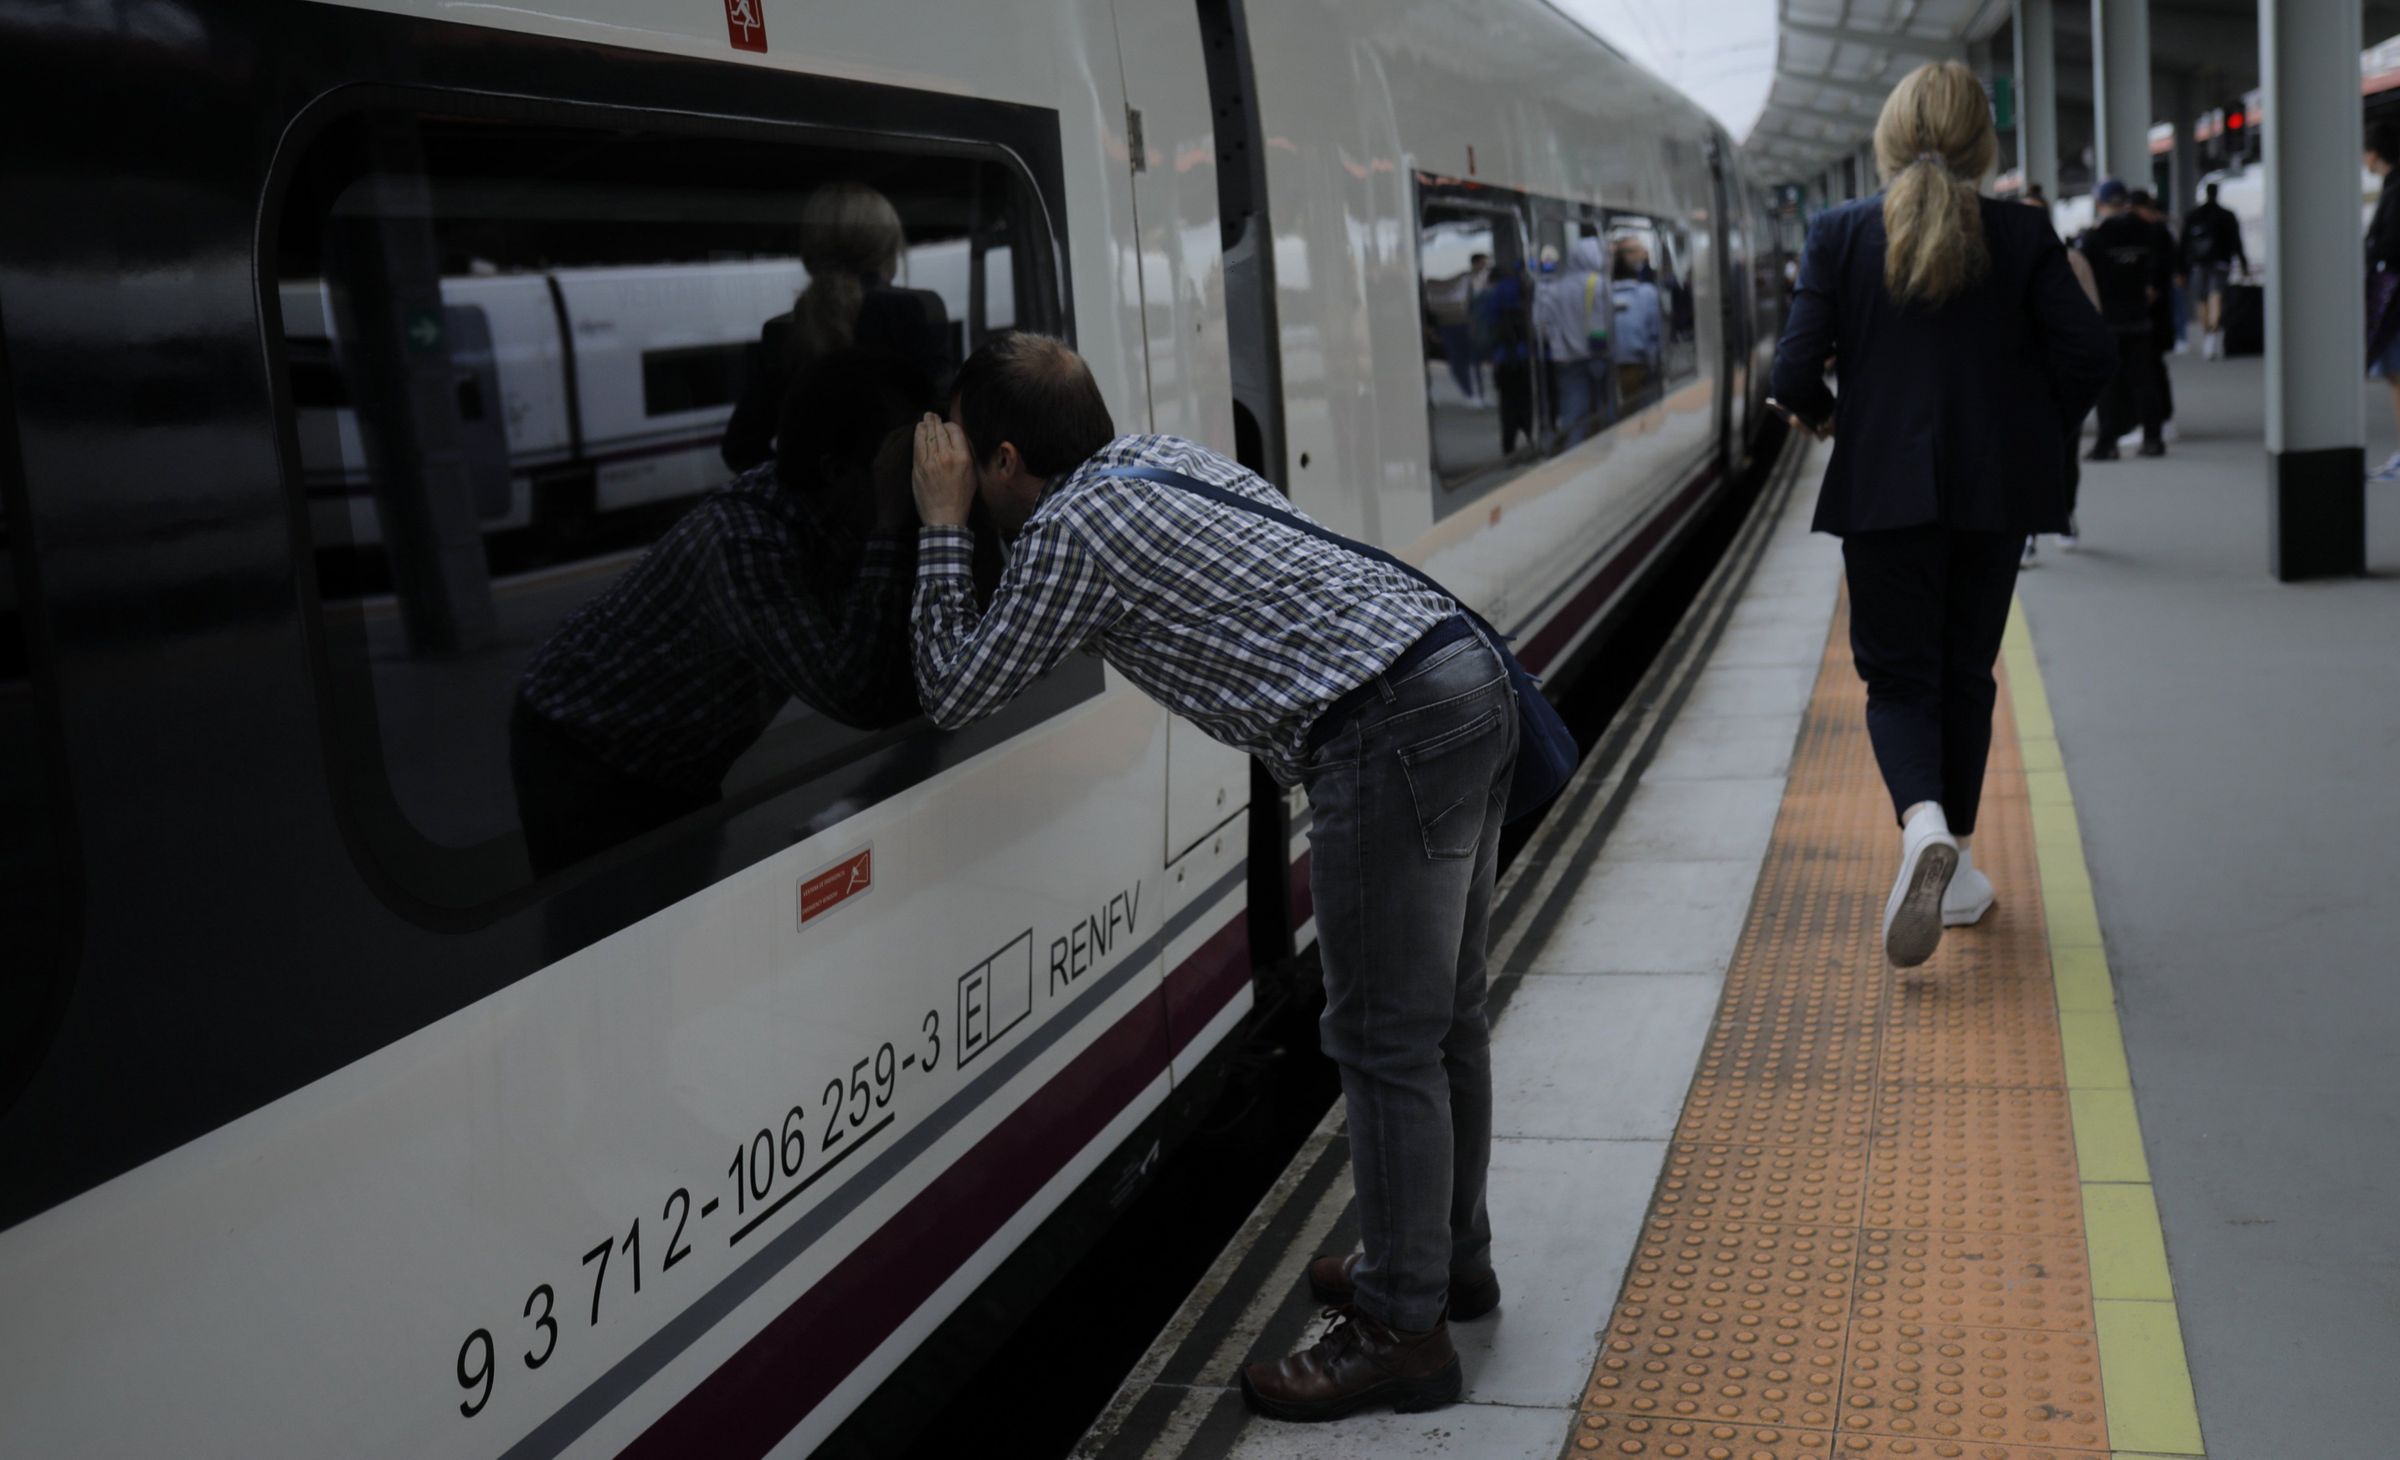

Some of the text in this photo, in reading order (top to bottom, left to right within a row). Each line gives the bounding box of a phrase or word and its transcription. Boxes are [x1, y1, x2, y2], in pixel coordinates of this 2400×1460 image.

[457, 1328, 494, 1418] 9
[523, 1284, 557, 1369] 3
[822, 1010, 940, 1152] 259-3
[966, 977, 982, 1050] E
[1050, 880, 1140, 996] RENFV
